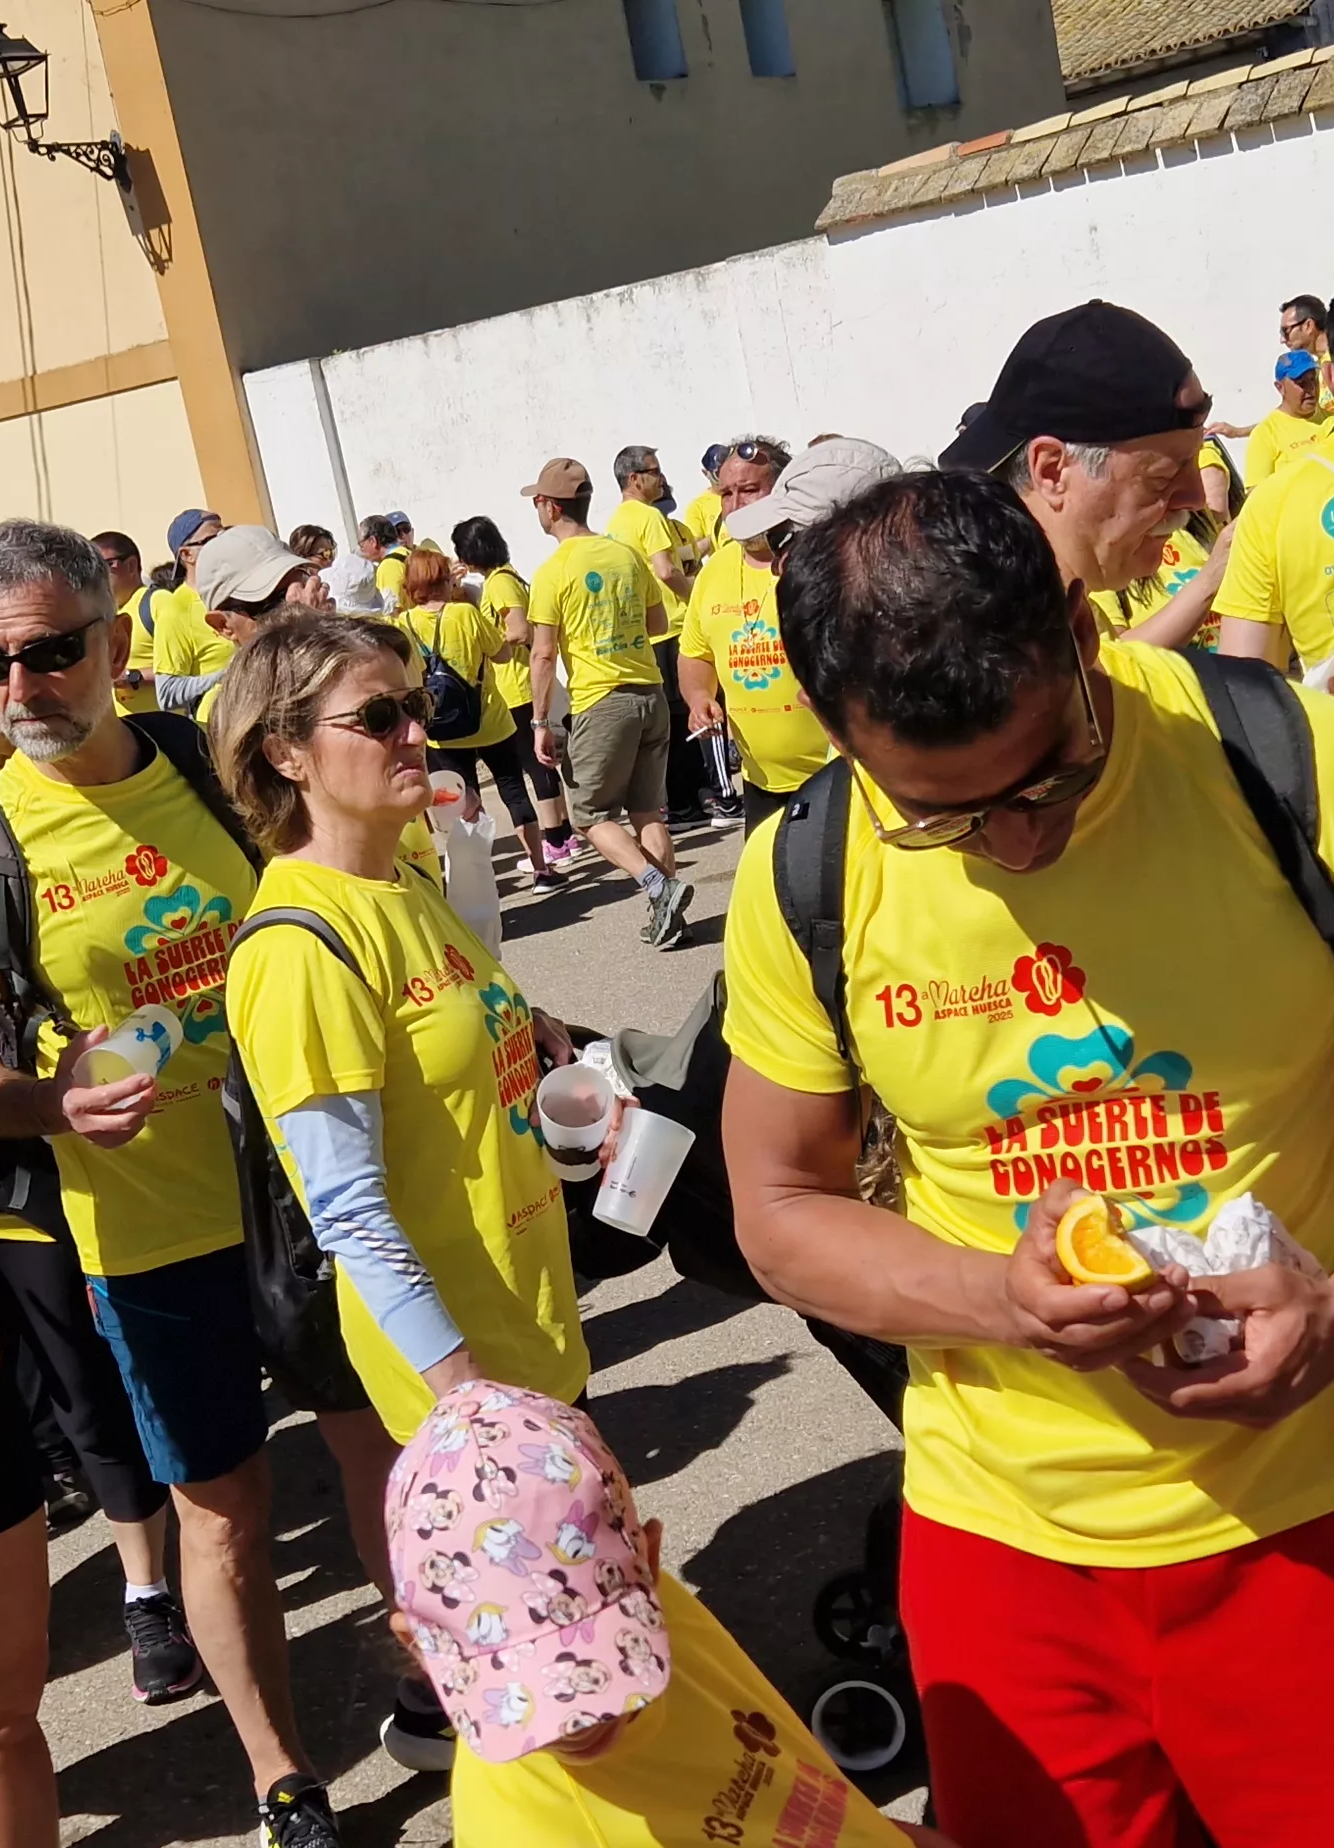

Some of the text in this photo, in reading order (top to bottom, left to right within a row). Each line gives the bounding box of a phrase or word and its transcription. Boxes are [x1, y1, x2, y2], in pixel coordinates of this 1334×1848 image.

[124, 956, 153, 986] LA
[155, 932, 226, 974] SUERTE
[928, 975, 1011, 1009] Marcha
[934, 997, 1013, 1020] ASPACE HUESCA
[988, 1009, 1014, 1024] 2025
[984, 1090, 1226, 1155] LA SUERTE DE
